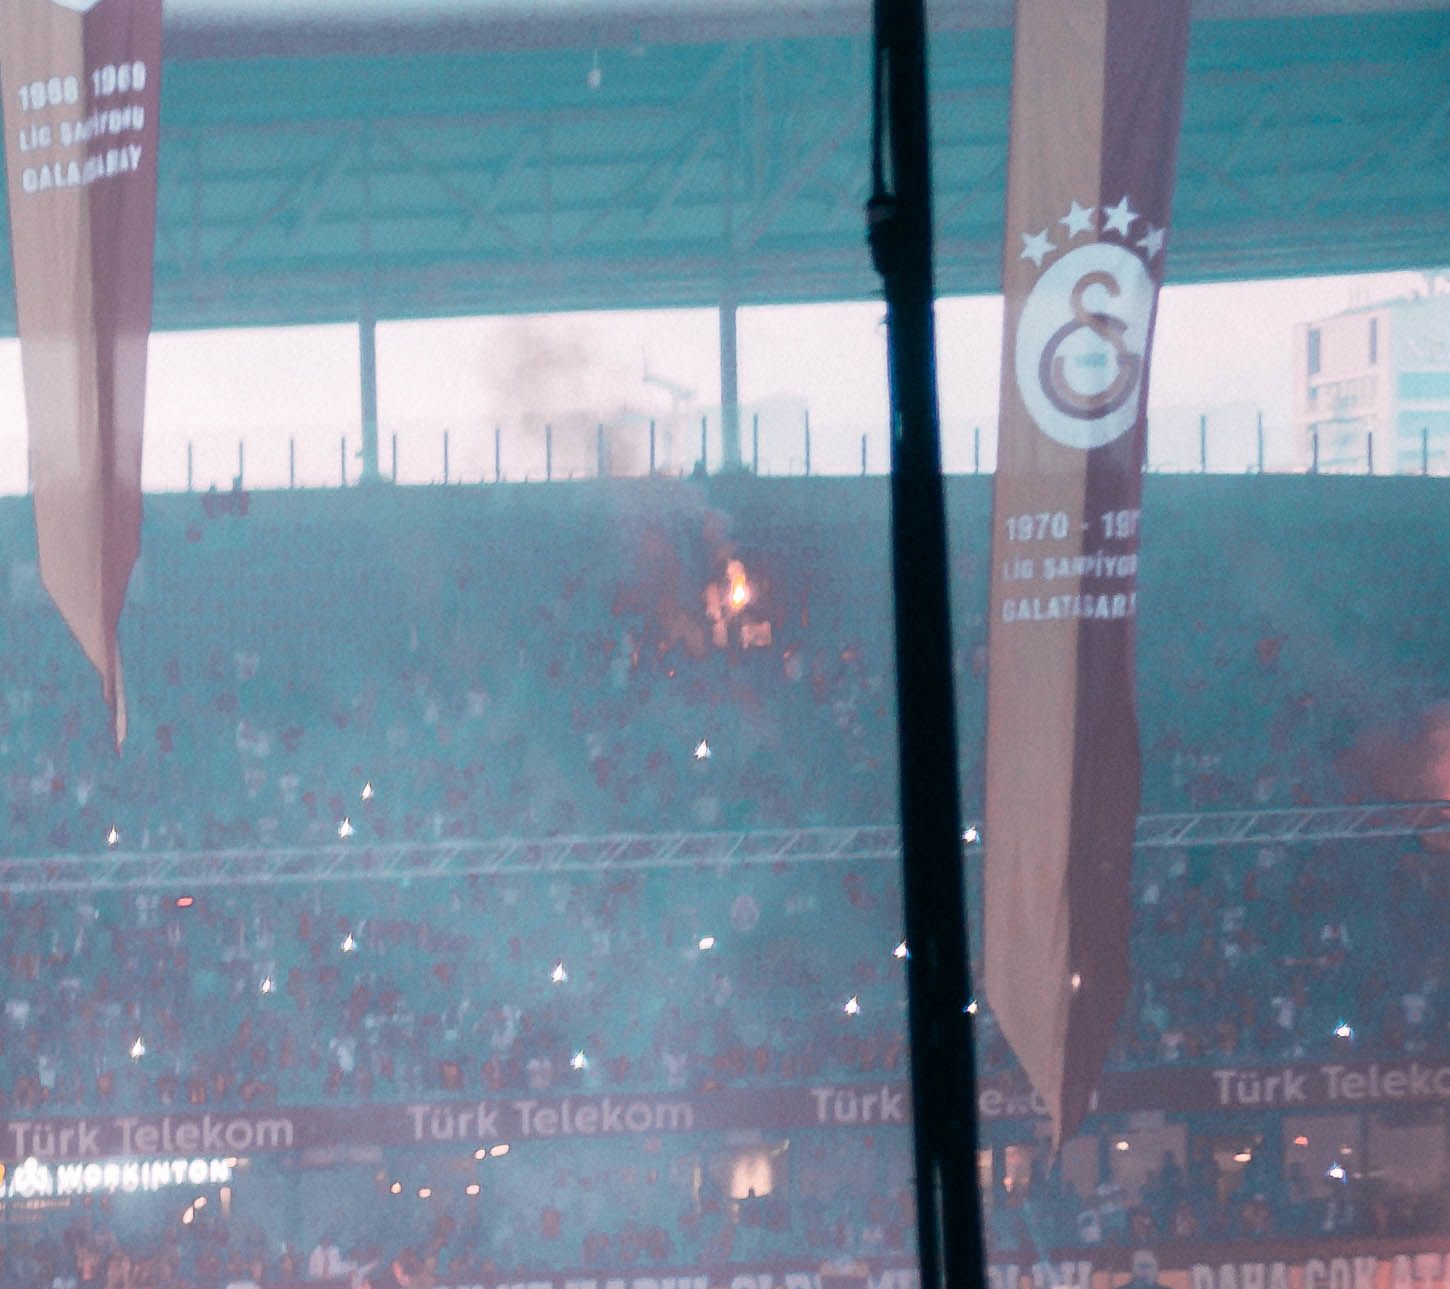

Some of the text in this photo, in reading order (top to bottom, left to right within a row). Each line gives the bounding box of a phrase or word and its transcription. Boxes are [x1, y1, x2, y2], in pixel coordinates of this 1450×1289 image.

[1006, 511, 1070, 541] 1970
[809, 1084, 904, 1124] Türk
[1213, 1069, 1309, 1105] Türk
[7, 1115, 295, 1160] Türk Telekom
[406, 1096, 694, 1142] Türk Telekom
